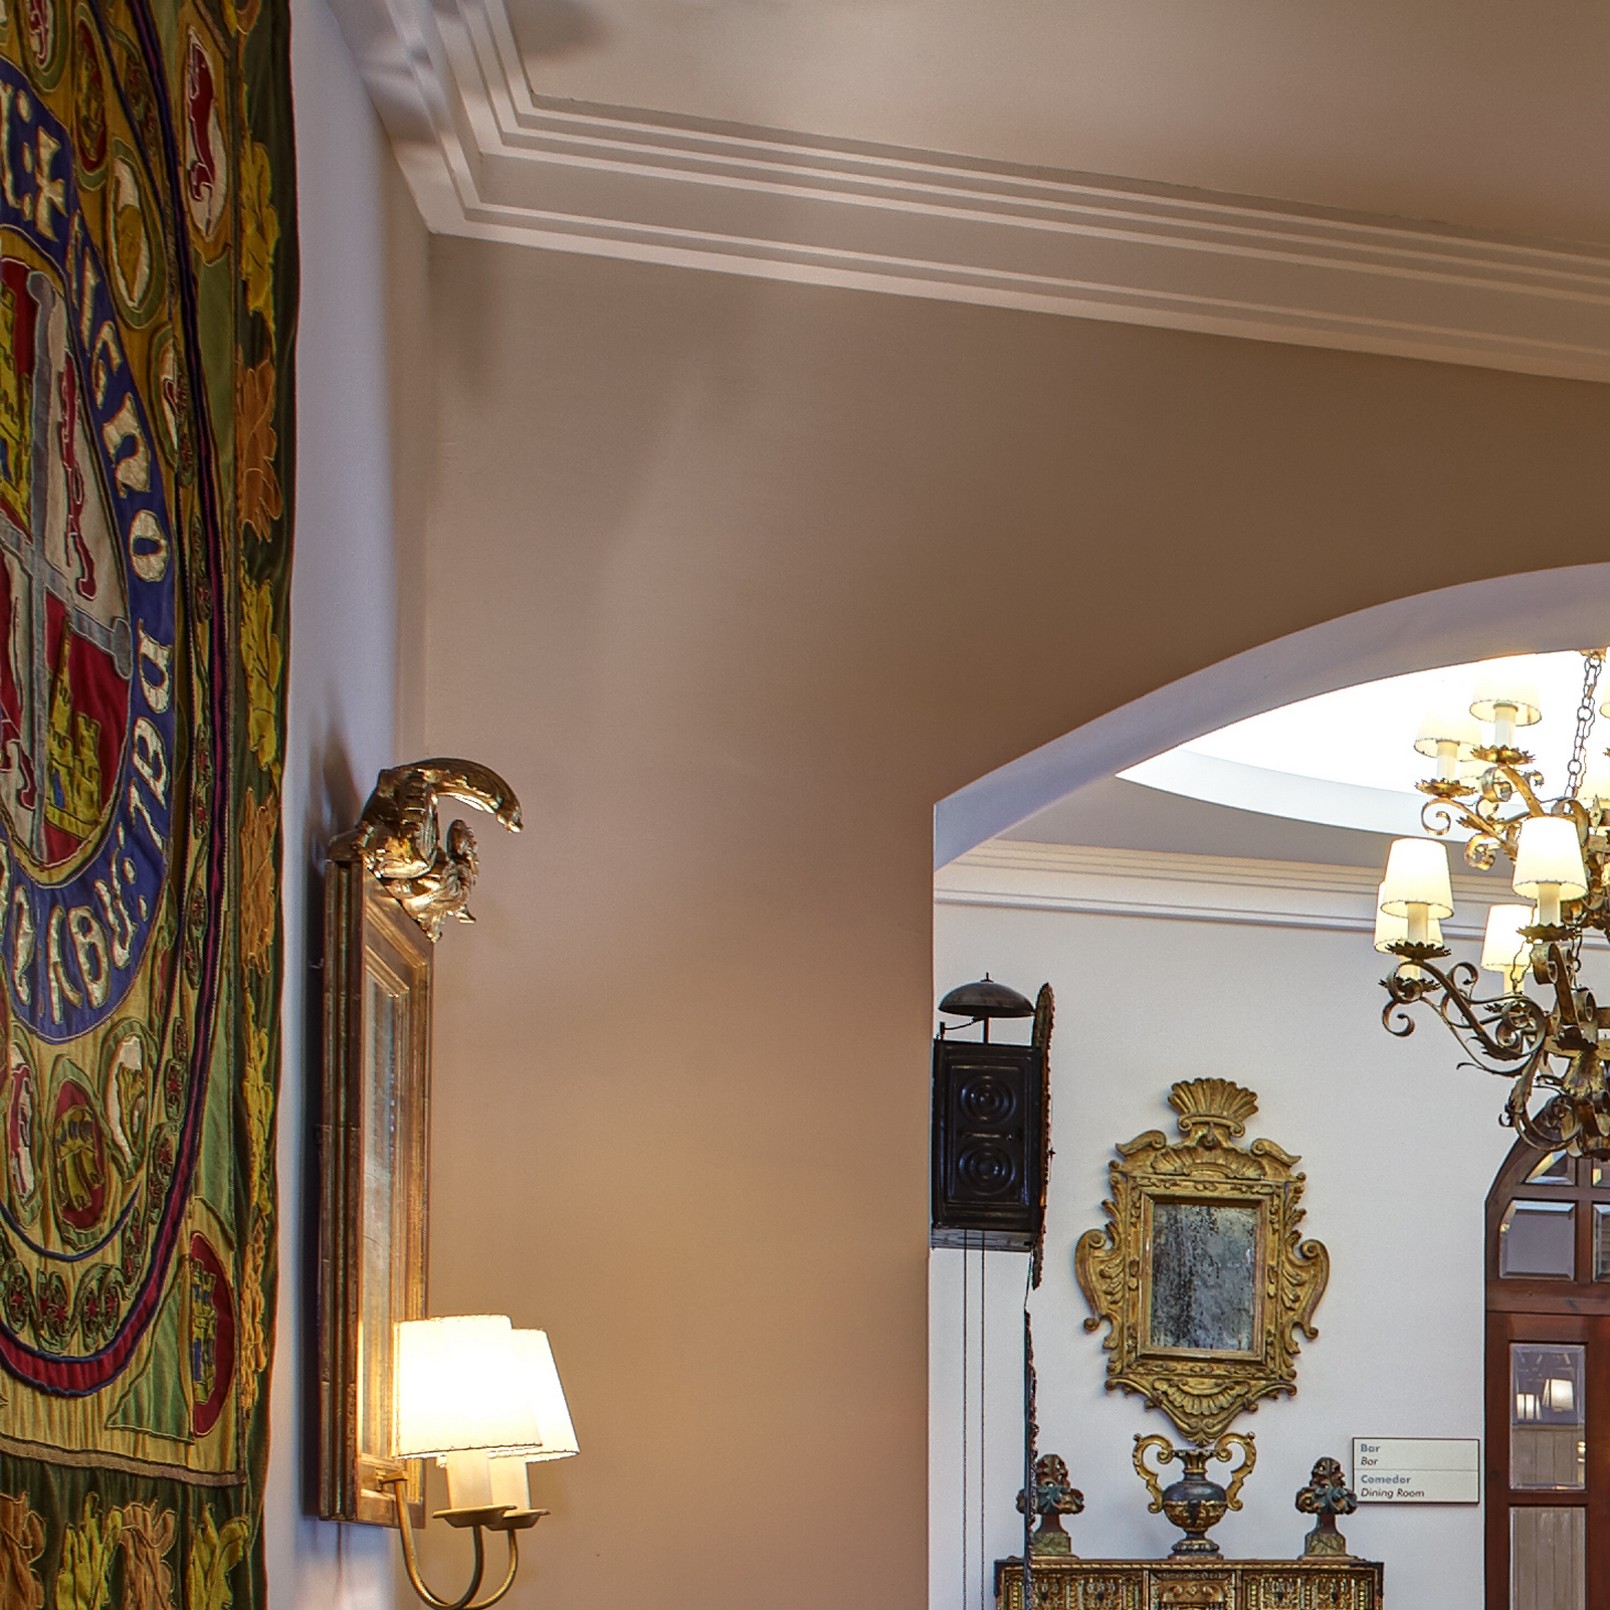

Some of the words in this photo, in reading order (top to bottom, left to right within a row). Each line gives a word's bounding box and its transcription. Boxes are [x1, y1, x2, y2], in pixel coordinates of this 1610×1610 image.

[1360, 1443, 1380, 1453] Bar
[1361, 1456, 1378, 1466] Bar
[1361, 1474, 1411, 1484] Comedor
[1361, 1488, 1394, 1499] Dining
[1396, 1488, 1425, 1497] Room
